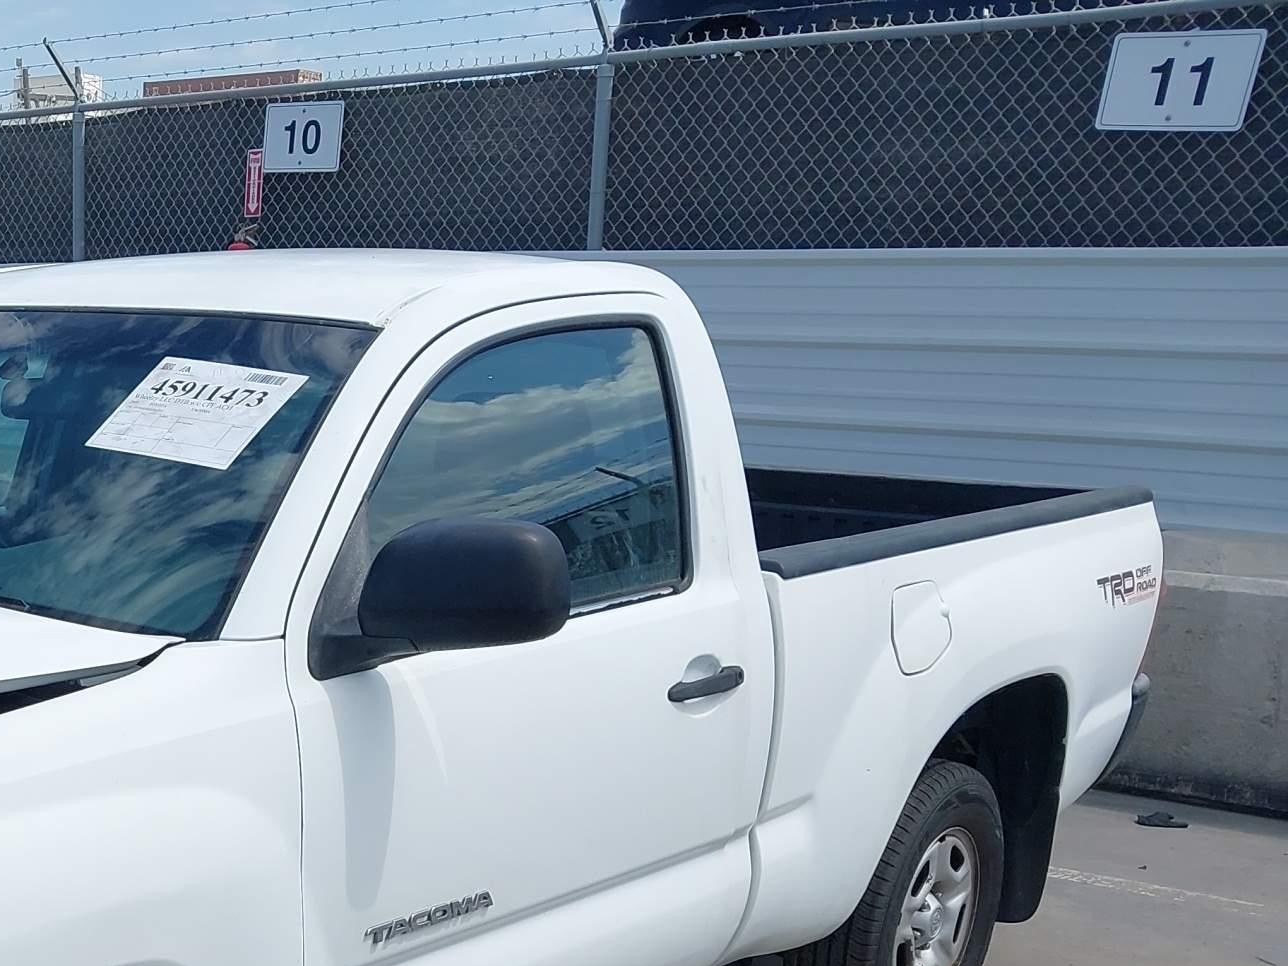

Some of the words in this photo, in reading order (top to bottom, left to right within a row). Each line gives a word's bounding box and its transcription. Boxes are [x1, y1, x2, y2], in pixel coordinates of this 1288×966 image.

[1150, 56, 1215, 106] 11
[283, 119, 322, 154] 10
[150, 378, 269, 408] 45911473
[1096, 570, 1135, 606] TRD
[1136, 565, 1152, 578] OFF
[1137, 577, 1156, 592] ROAD
[364, 891, 494, 944] TACOMA
